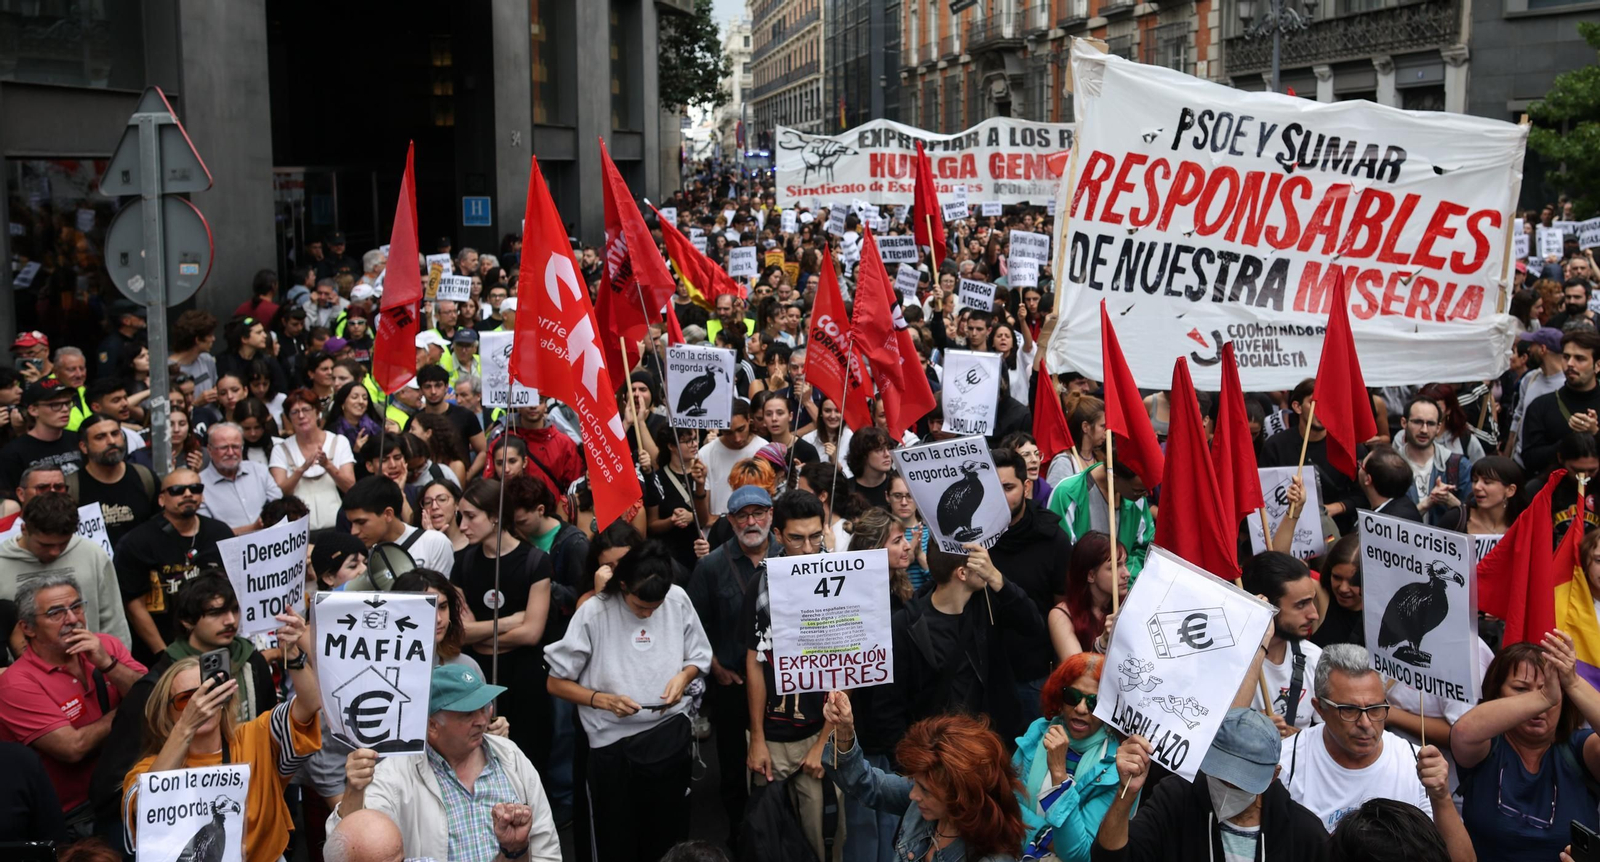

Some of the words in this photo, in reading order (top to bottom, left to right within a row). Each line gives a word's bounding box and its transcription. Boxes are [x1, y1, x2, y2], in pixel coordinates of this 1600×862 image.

[987, 127, 999, 146] A
[1010, 127, 1050, 147] LOS
[1171, 106, 1254, 156] PSOE
[1275, 122, 1407, 184] SUMAR
[786, 182, 866, 197] Sindicato
[869, 181, 884, 192] de
[888, 181, 983, 193] Estiaes
[471, 200, 483, 216] H
[1070, 150, 1502, 275] RESPONSABLES
[880, 238, 914, 247] ¡DERECHO
[888, 250, 916, 259] TECHO!
[440, 278, 469, 286] DERECHO
[1069, 231, 1114, 291] DE
[1111, 237, 1291, 312] NUESTRA
[963, 281, 992, 296] DERECHO
[967, 297, 990, 310] TECHO.
[669, 349, 686, 359] Con
[688, 351, 695, 360] la
[697, 352, 722, 362] crisis,
[1235, 351, 1307, 368] SOCIALISTA
[669, 363, 703, 373] engorda
[490, 391, 529, 404] LADRLAZO
[672, 417, 697, 427] BANCO
[949, 417, 988, 434] LADRILLAZO
[901, 450, 927, 463] Con
[928, 447, 941, 460] la
[943, 442, 983, 458] crisis,
[908, 464, 959, 483] engorda
[78, 517, 105, 538] ogar,
[941, 540, 971, 555] BANC
[979, 530, 1007, 550] UITR
[1364, 516, 1392, 540] Con
[1397, 524, 1409, 545] la
[1413, 531, 1462, 561] crisis,
[242, 530, 307, 570] ¡Derechos
[1367, 544, 1423, 576] engorda
[247, 560, 304, 593] humanos
[791, 558, 865, 576] ARTÍCULO
[813, 576, 846, 598] 47
[246, 606, 255, 621] a
[259, 581, 303, 619] TODOS!
[779, 644, 886, 671] EXPROPIACIÓN
[781, 662, 888, 693] BUITRES
[1374, 653, 1412, 686] BANCO
[1414, 671, 1470, 703] BUITRE.
[1111, 694, 1190, 771] LADRILLAZO
[149, 775, 180, 793] Con
[185, 771, 197, 789] la
[201, 768, 244, 789] crisis,
[146, 797, 209, 826] engorda
